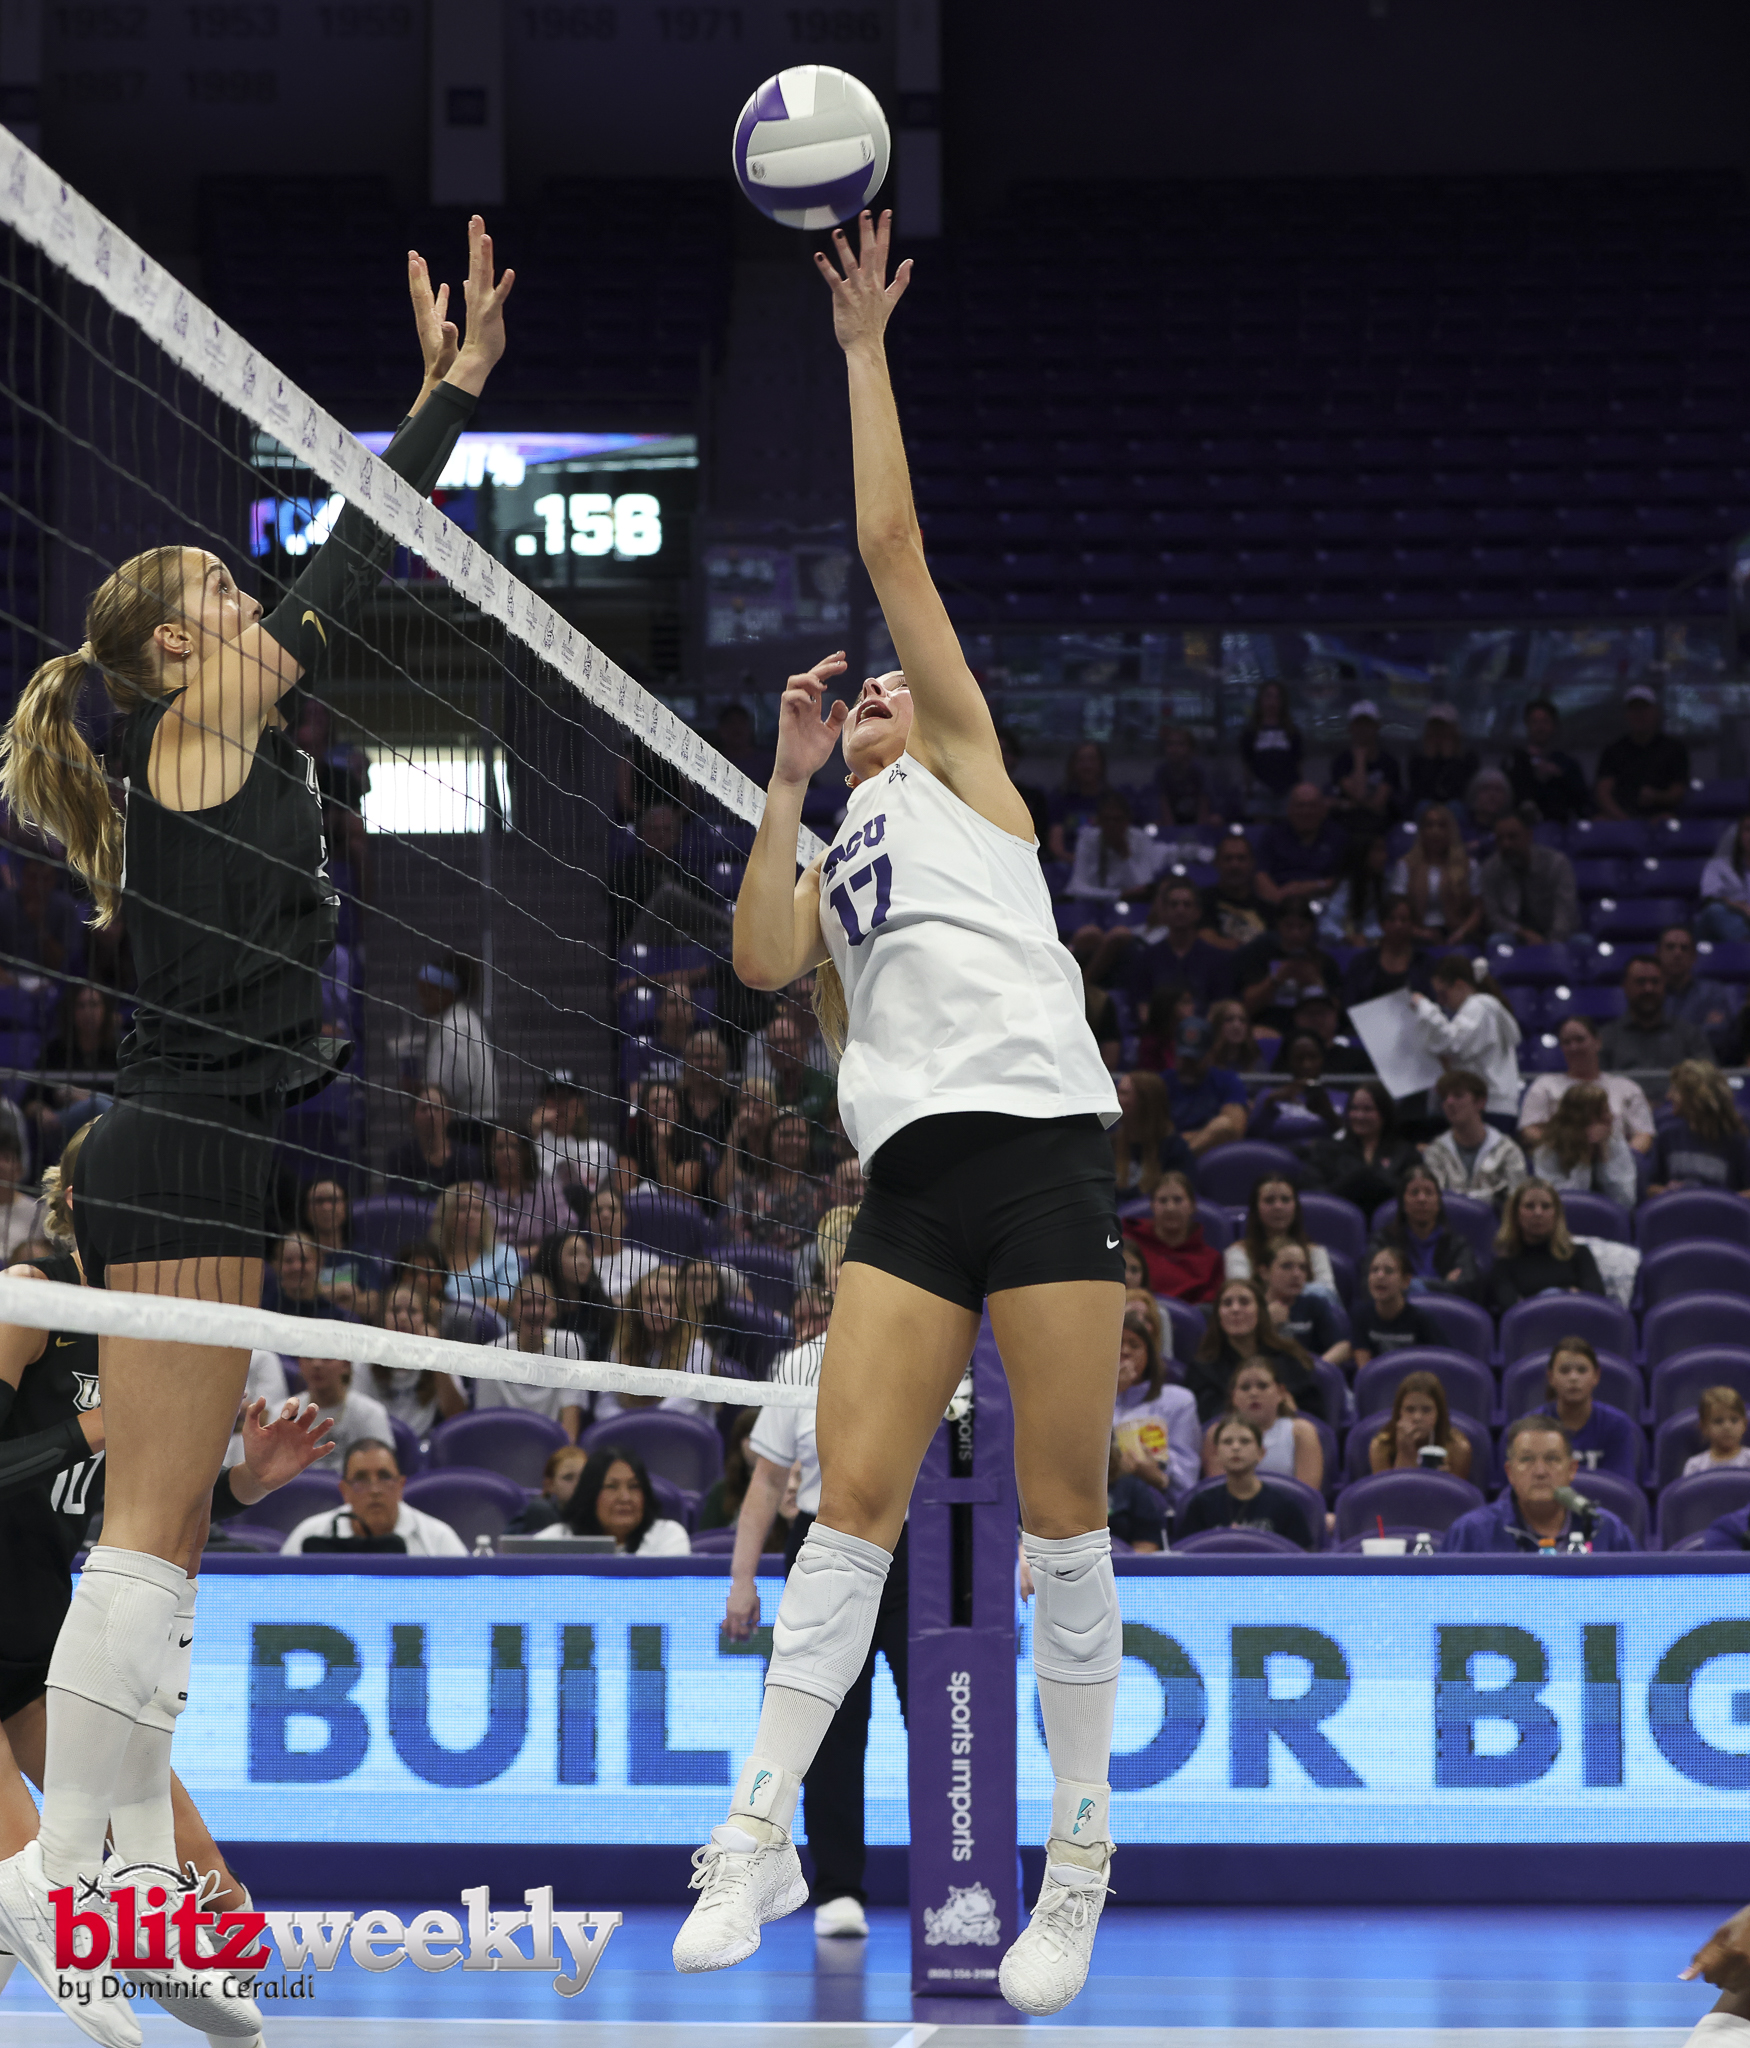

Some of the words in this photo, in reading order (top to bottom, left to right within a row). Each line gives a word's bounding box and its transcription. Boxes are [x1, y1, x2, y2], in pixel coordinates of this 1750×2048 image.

[653, 6, 745, 42] 1971
[829, 852, 893, 947] 17
[947, 1671, 974, 1756] sports
[947, 1759, 974, 1862] imports
